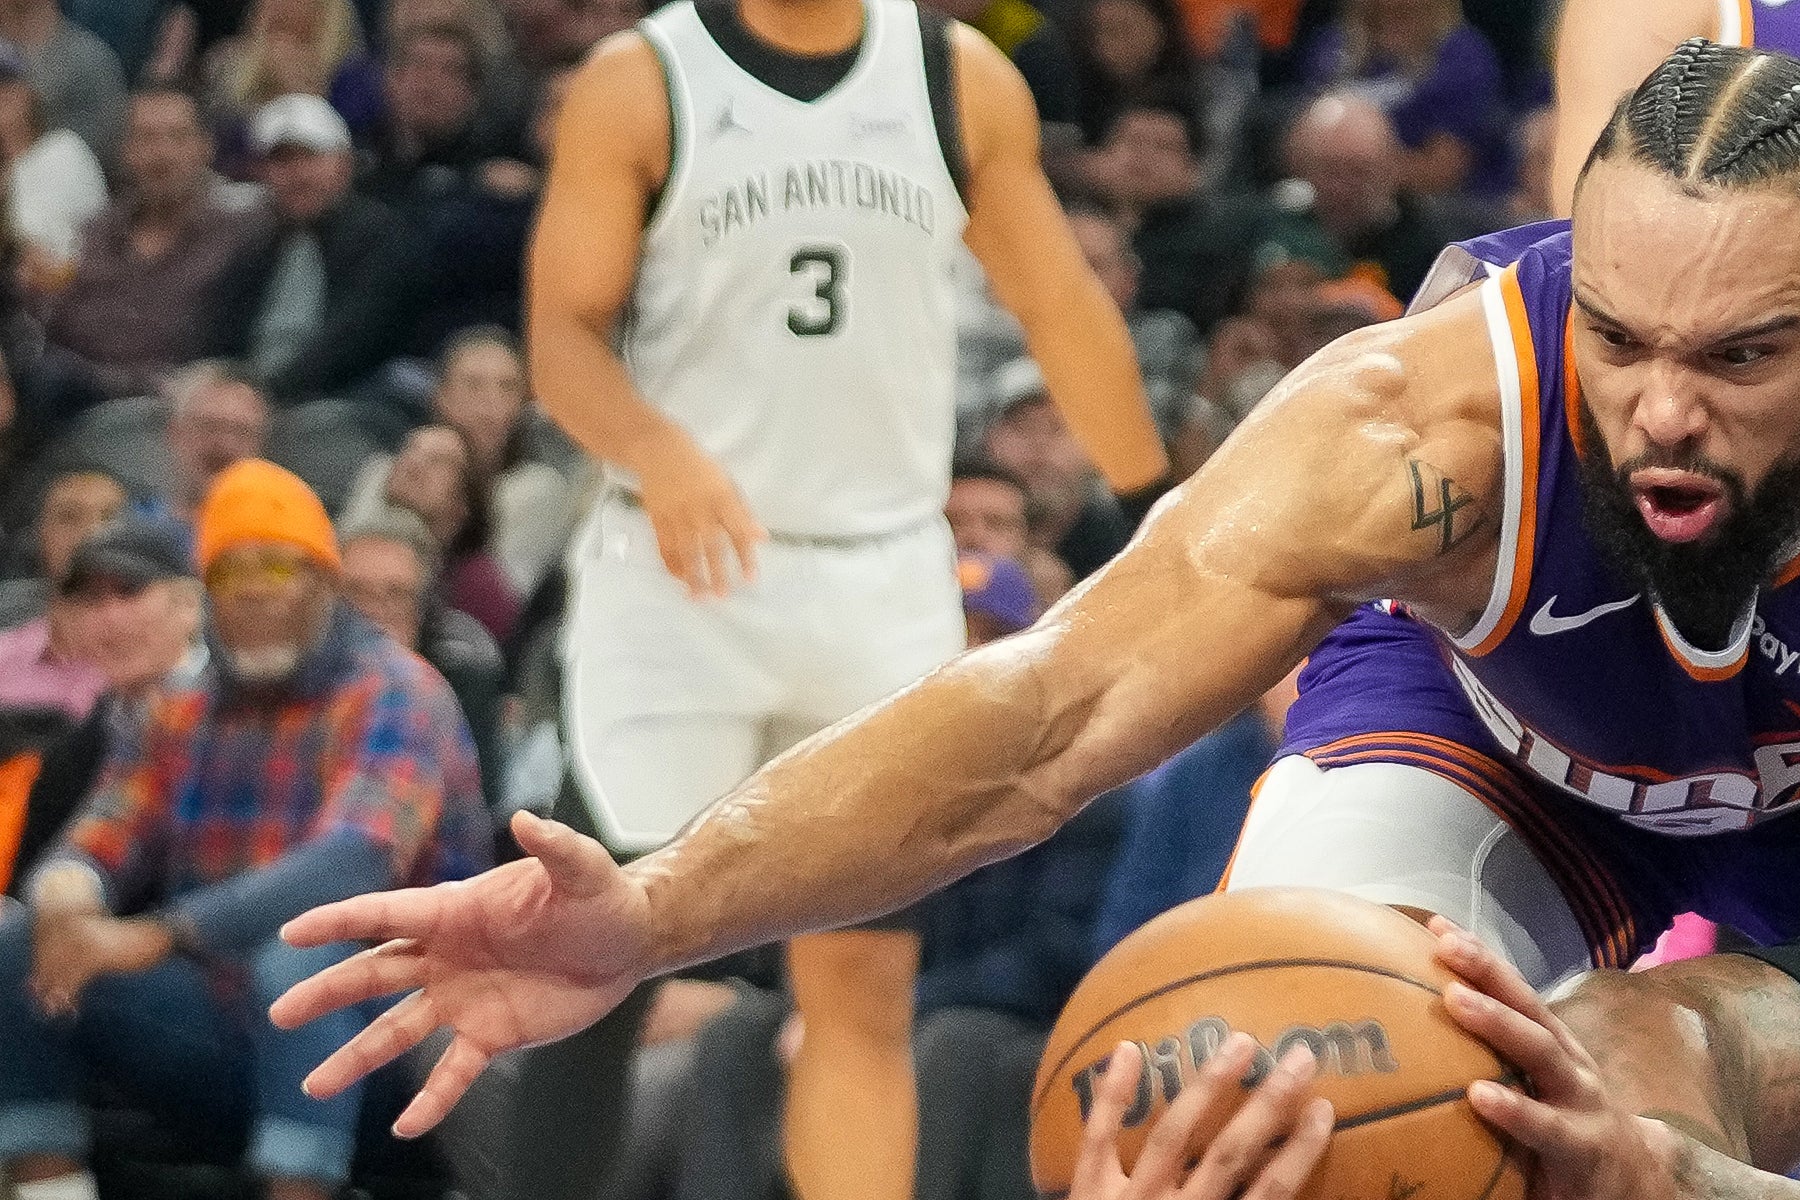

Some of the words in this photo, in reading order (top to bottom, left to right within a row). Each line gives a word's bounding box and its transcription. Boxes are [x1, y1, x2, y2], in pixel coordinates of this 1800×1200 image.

[700, 172, 771, 248] SAN
[783, 160, 936, 238] ANTONIO
[786, 242, 850, 336] 3
